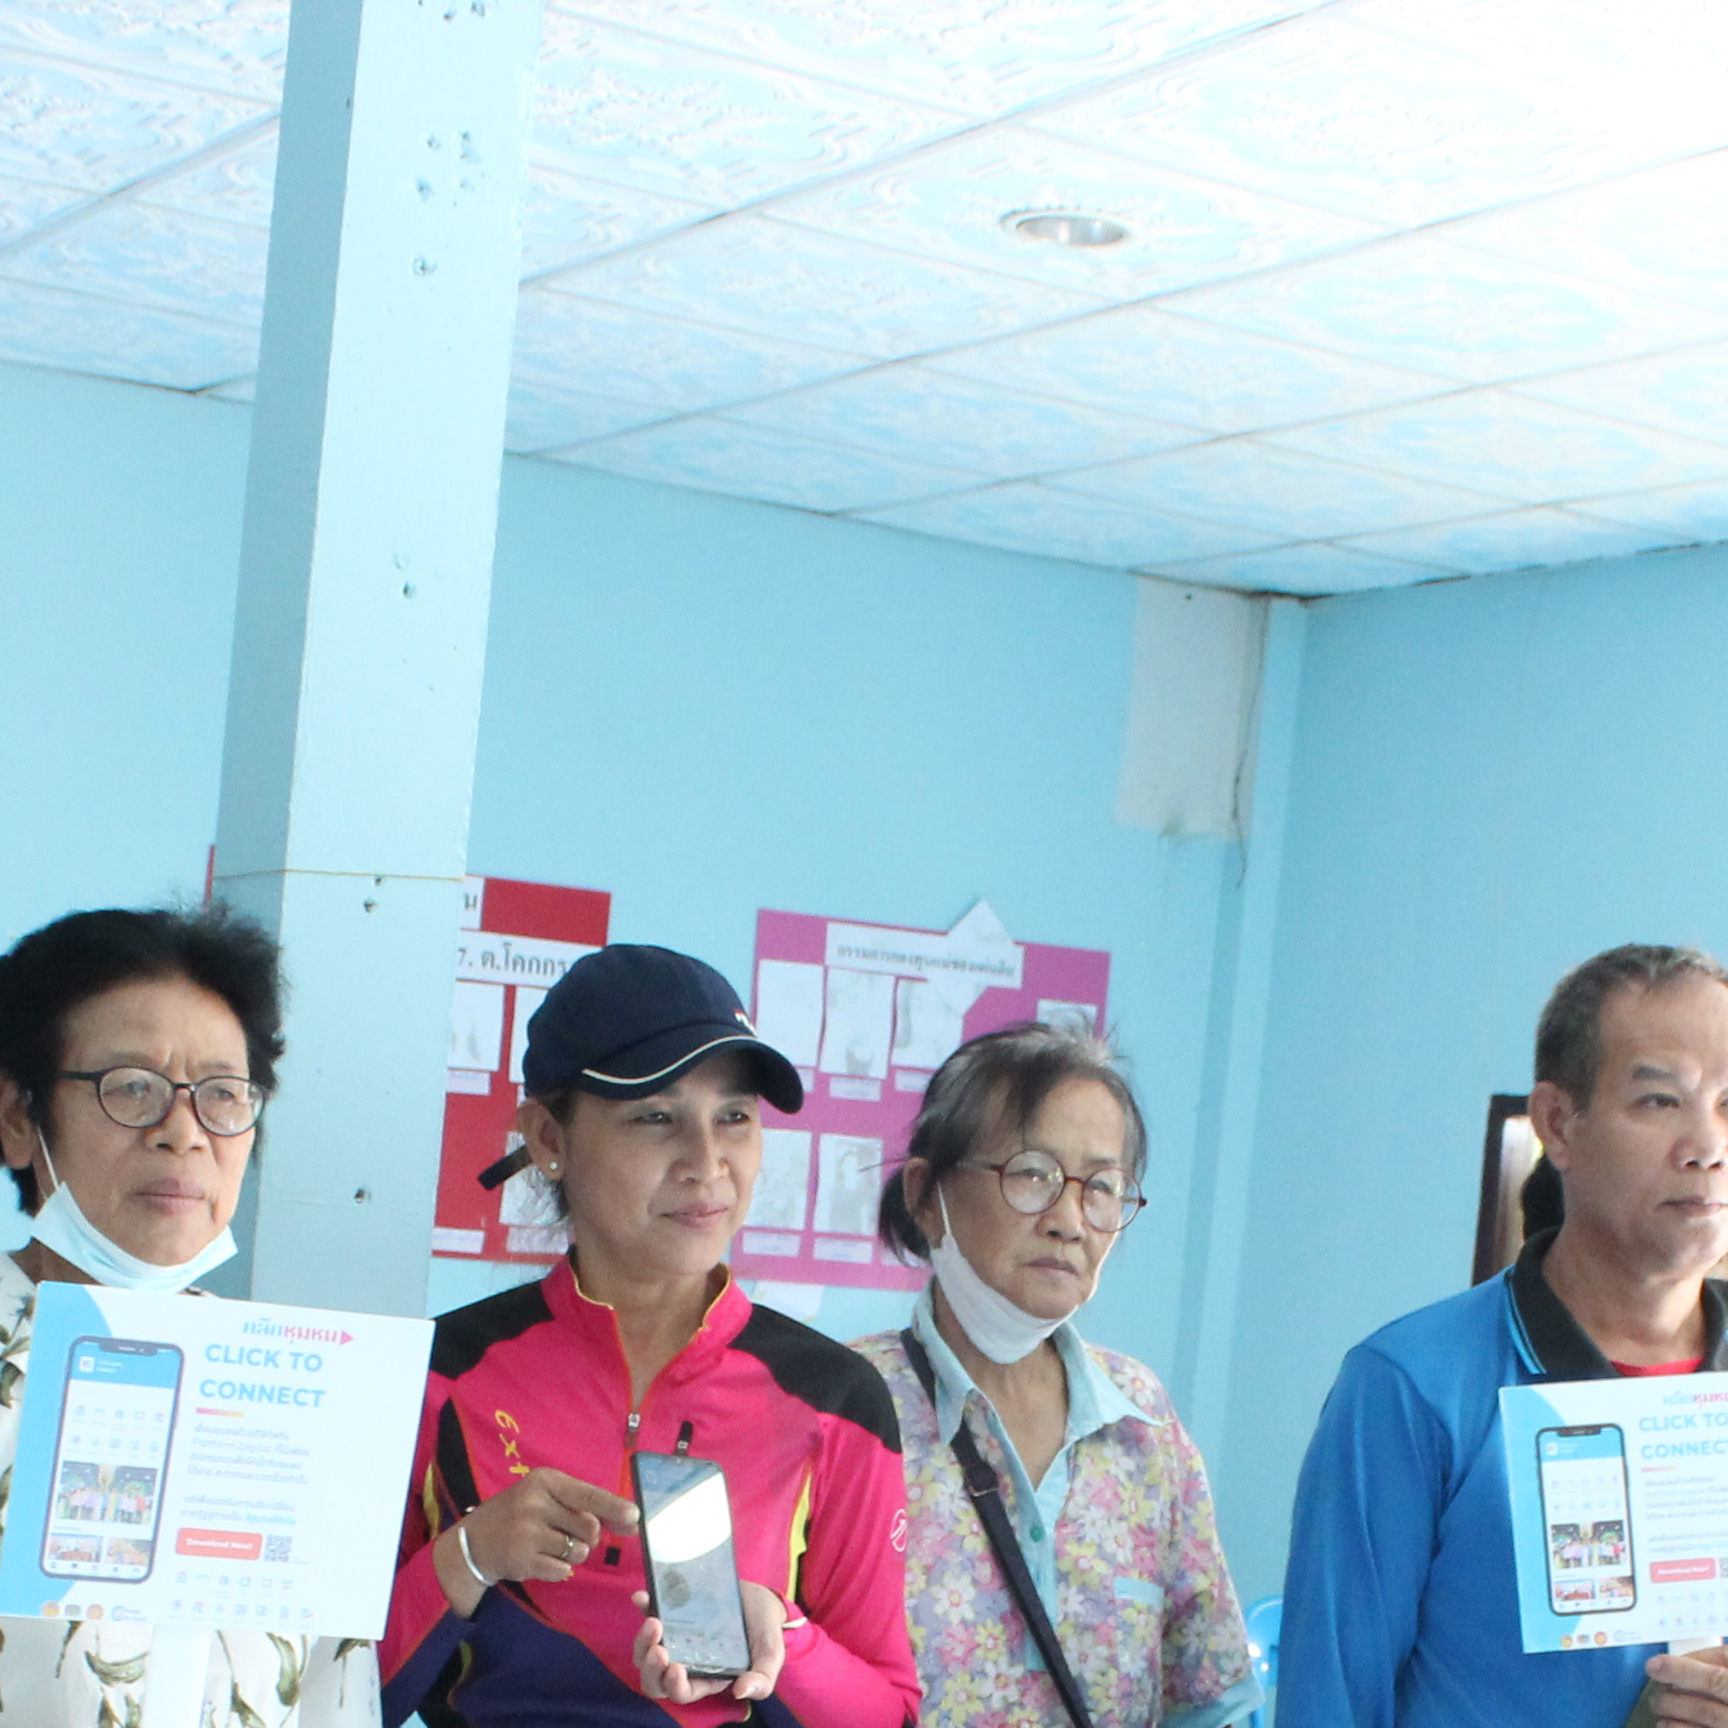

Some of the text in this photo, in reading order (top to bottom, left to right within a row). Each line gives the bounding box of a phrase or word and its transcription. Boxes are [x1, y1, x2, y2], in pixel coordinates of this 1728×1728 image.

[481, 941, 568, 977] ต.โคกกร
[205, 1344, 323, 1373] CLICK TO
[199, 1379, 327, 1408] CONNECT
[1638, 1414, 1697, 1432] CLICK
[186, 1537, 253, 1550] Download Now!
